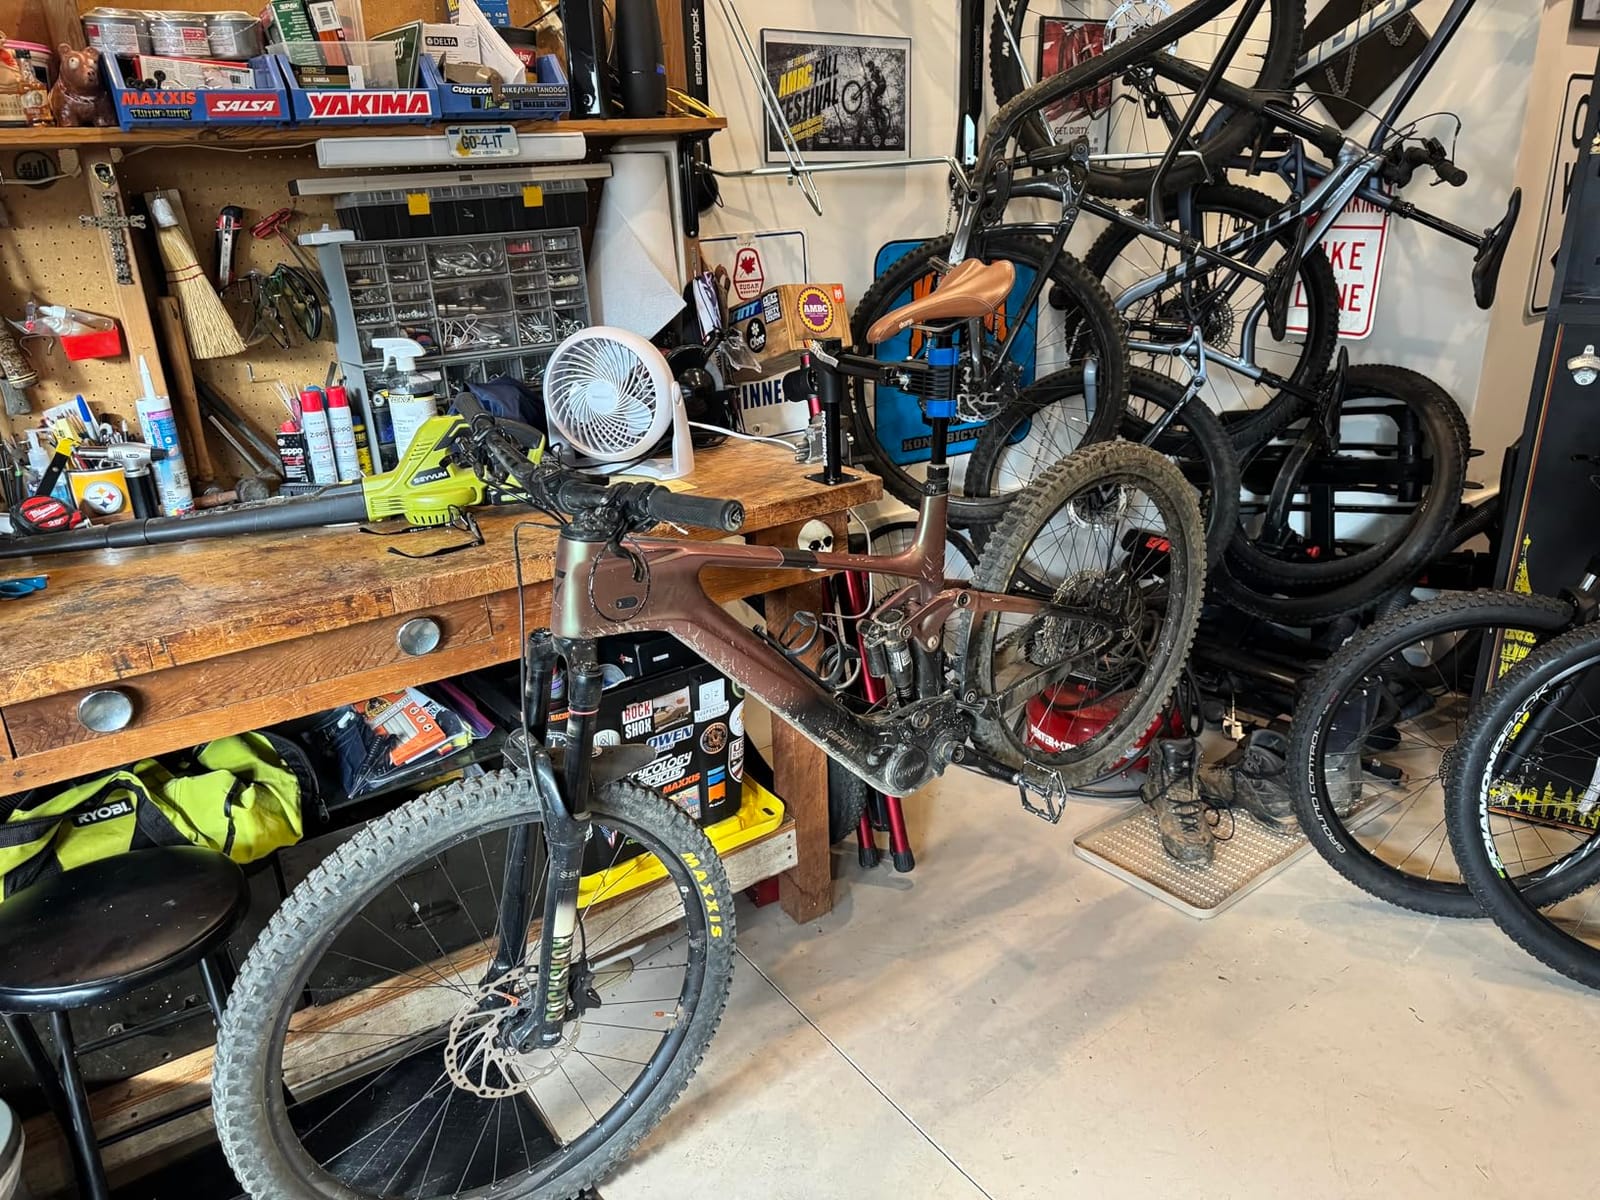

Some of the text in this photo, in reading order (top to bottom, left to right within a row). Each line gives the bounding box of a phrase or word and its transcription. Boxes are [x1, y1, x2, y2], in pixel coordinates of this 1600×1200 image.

[433, 38, 457, 47] DELTA
[690, 7, 703, 86] steadyrack
[1293, 0, 1406, 77] GIAN
[778, 63, 813, 98] AMBC
[814, 53, 839, 83] FALL
[121, 91, 197, 105] MAXXIS
[211, 100, 276, 113] SALSA
[309, 92, 432, 116] YAKIMA
[461, 134, 503, 150] GO-4-IT
[1320, 241, 1366, 271] IKE
[803, 303, 828, 313] AMBC
[1295, 281, 1364, 312] LNE
[742, 378, 783, 410] INNE
[903, 437, 933, 451] KON
[623, 701, 652, 721] ROCK
[624, 718, 652, 739] SHOX
[825, 729, 860, 752] GIANT
[662, 772, 701, 794] MAXXIS
[1479, 683, 1551, 870] DIAMONDBACK
[680, 851, 723, 938] MAXXIS
